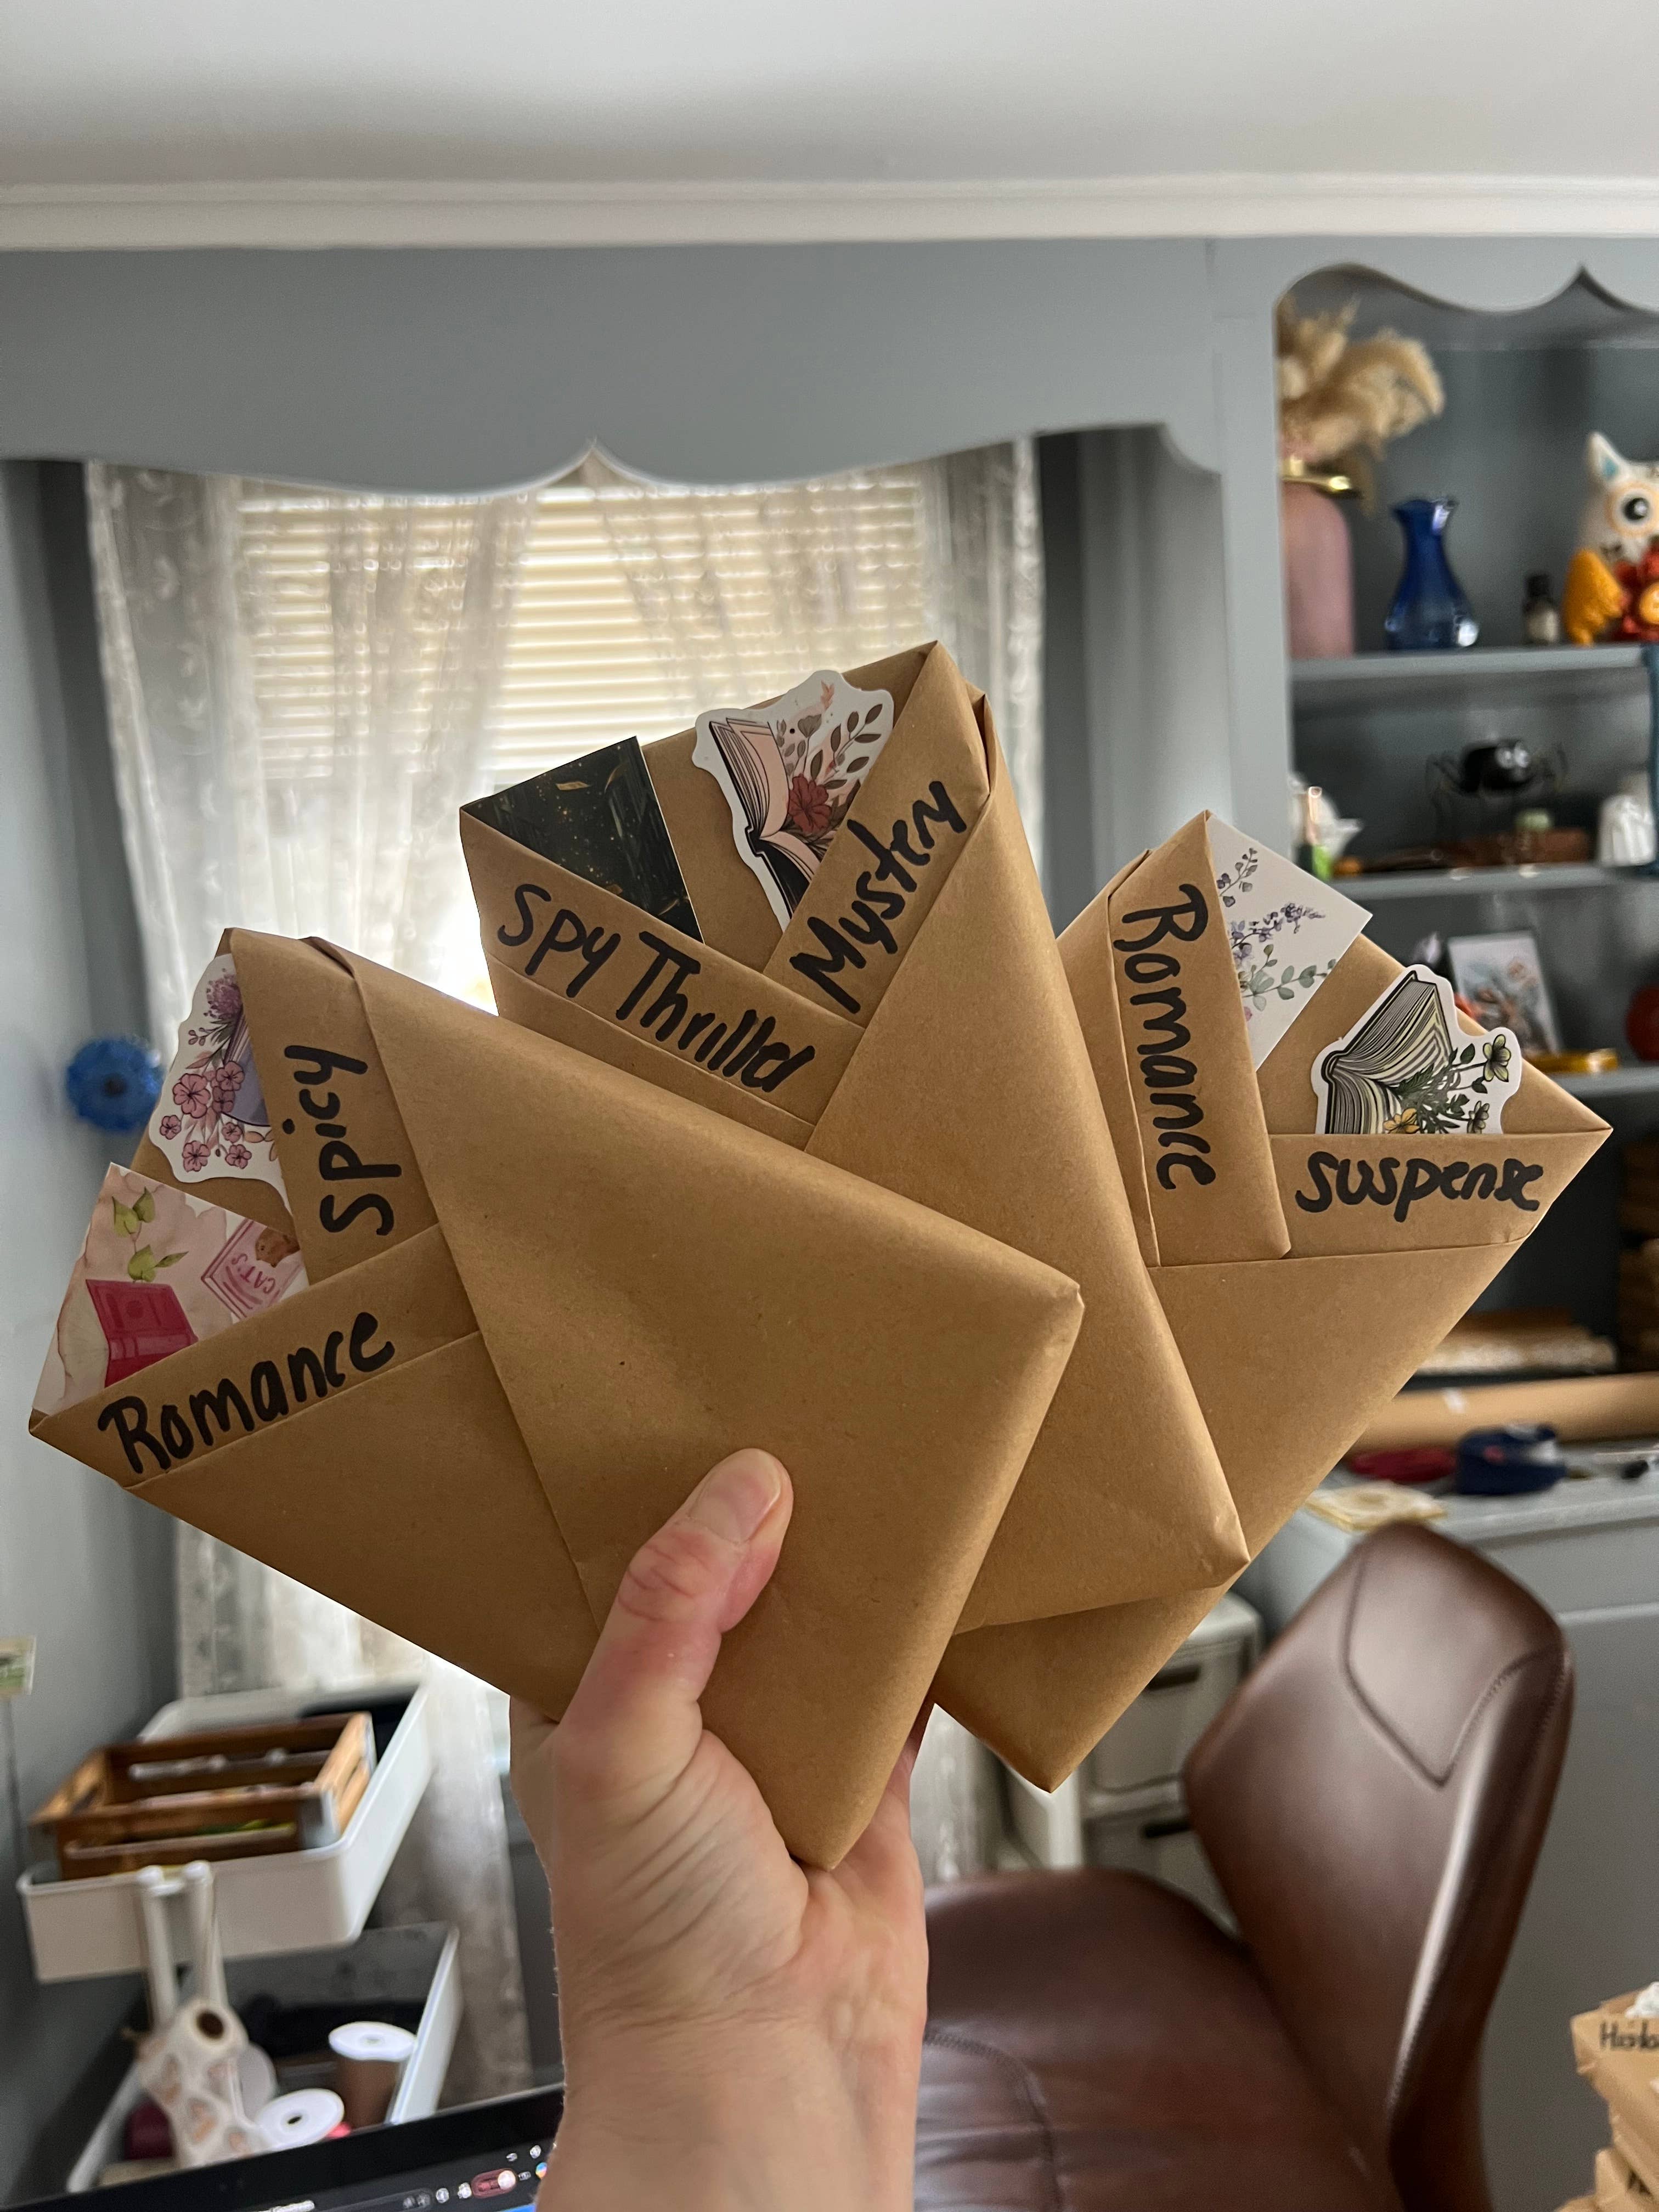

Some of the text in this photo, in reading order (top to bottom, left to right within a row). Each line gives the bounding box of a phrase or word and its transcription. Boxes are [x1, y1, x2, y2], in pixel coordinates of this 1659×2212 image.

[497, 883, 816, 1093] Spy Thriller
[789, 780, 968, 1015] Mystery
[1112, 883, 1217, 1190] Romance
[281, 1044, 403, 1237] Spicy
[232, 1253, 276, 1295] CAT'S
[97, 1311, 396, 1475] Romance
